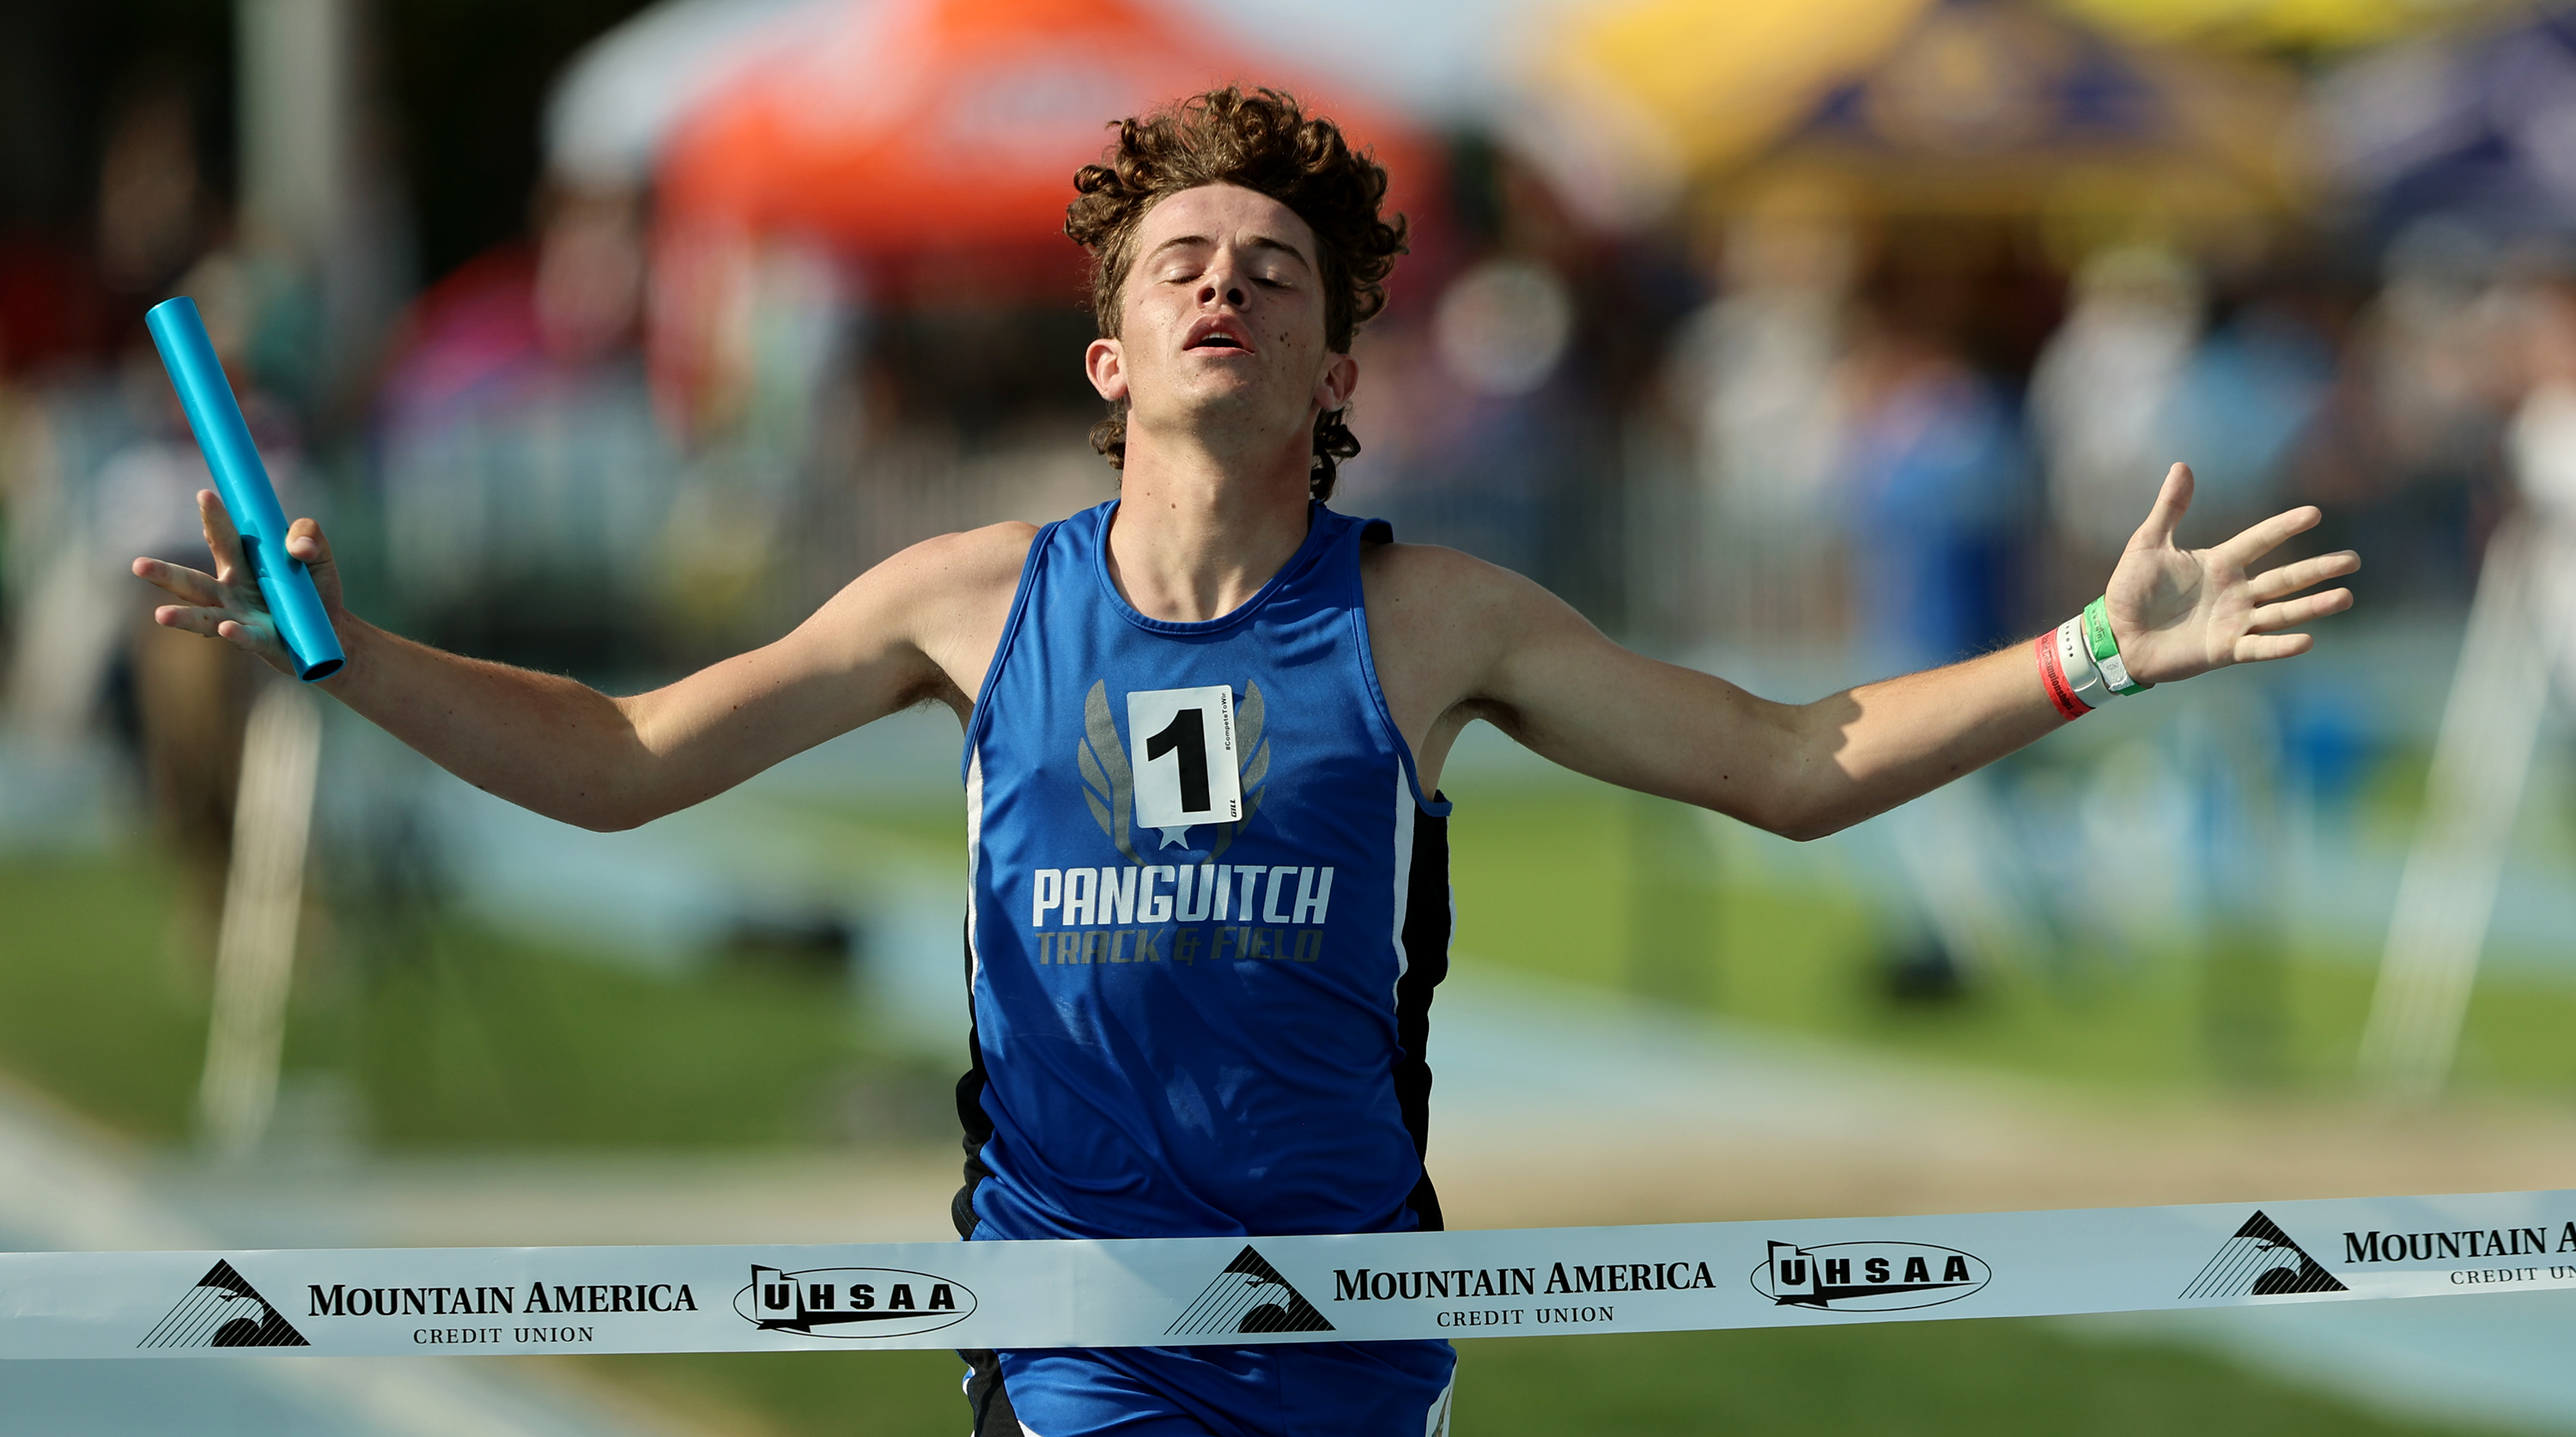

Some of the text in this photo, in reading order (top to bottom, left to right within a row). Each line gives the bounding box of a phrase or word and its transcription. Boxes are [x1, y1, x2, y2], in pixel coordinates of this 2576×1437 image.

[1145, 709, 1211, 813] 1
[1033, 864, 1334, 927] PANGUITCH
[1035, 926, 1324, 965] TRACK & FIELD
[2342, 1227, 2548, 1263] MOUNTAIN
[1333, 1262, 1716, 1301] MOUNTAIN AMERICA
[1781, 1255, 1970, 1285] UHSAA
[2451, 1268, 2537, 1285] CREDIT
[307, 1282, 698, 1317] MOUNTAIN AMERICA
[764, 1283, 955, 1310] UHSAA
[1437, 1306, 1614, 1327] CREDIT UNION
[413, 1326, 594, 1344] CREDIT UNION
